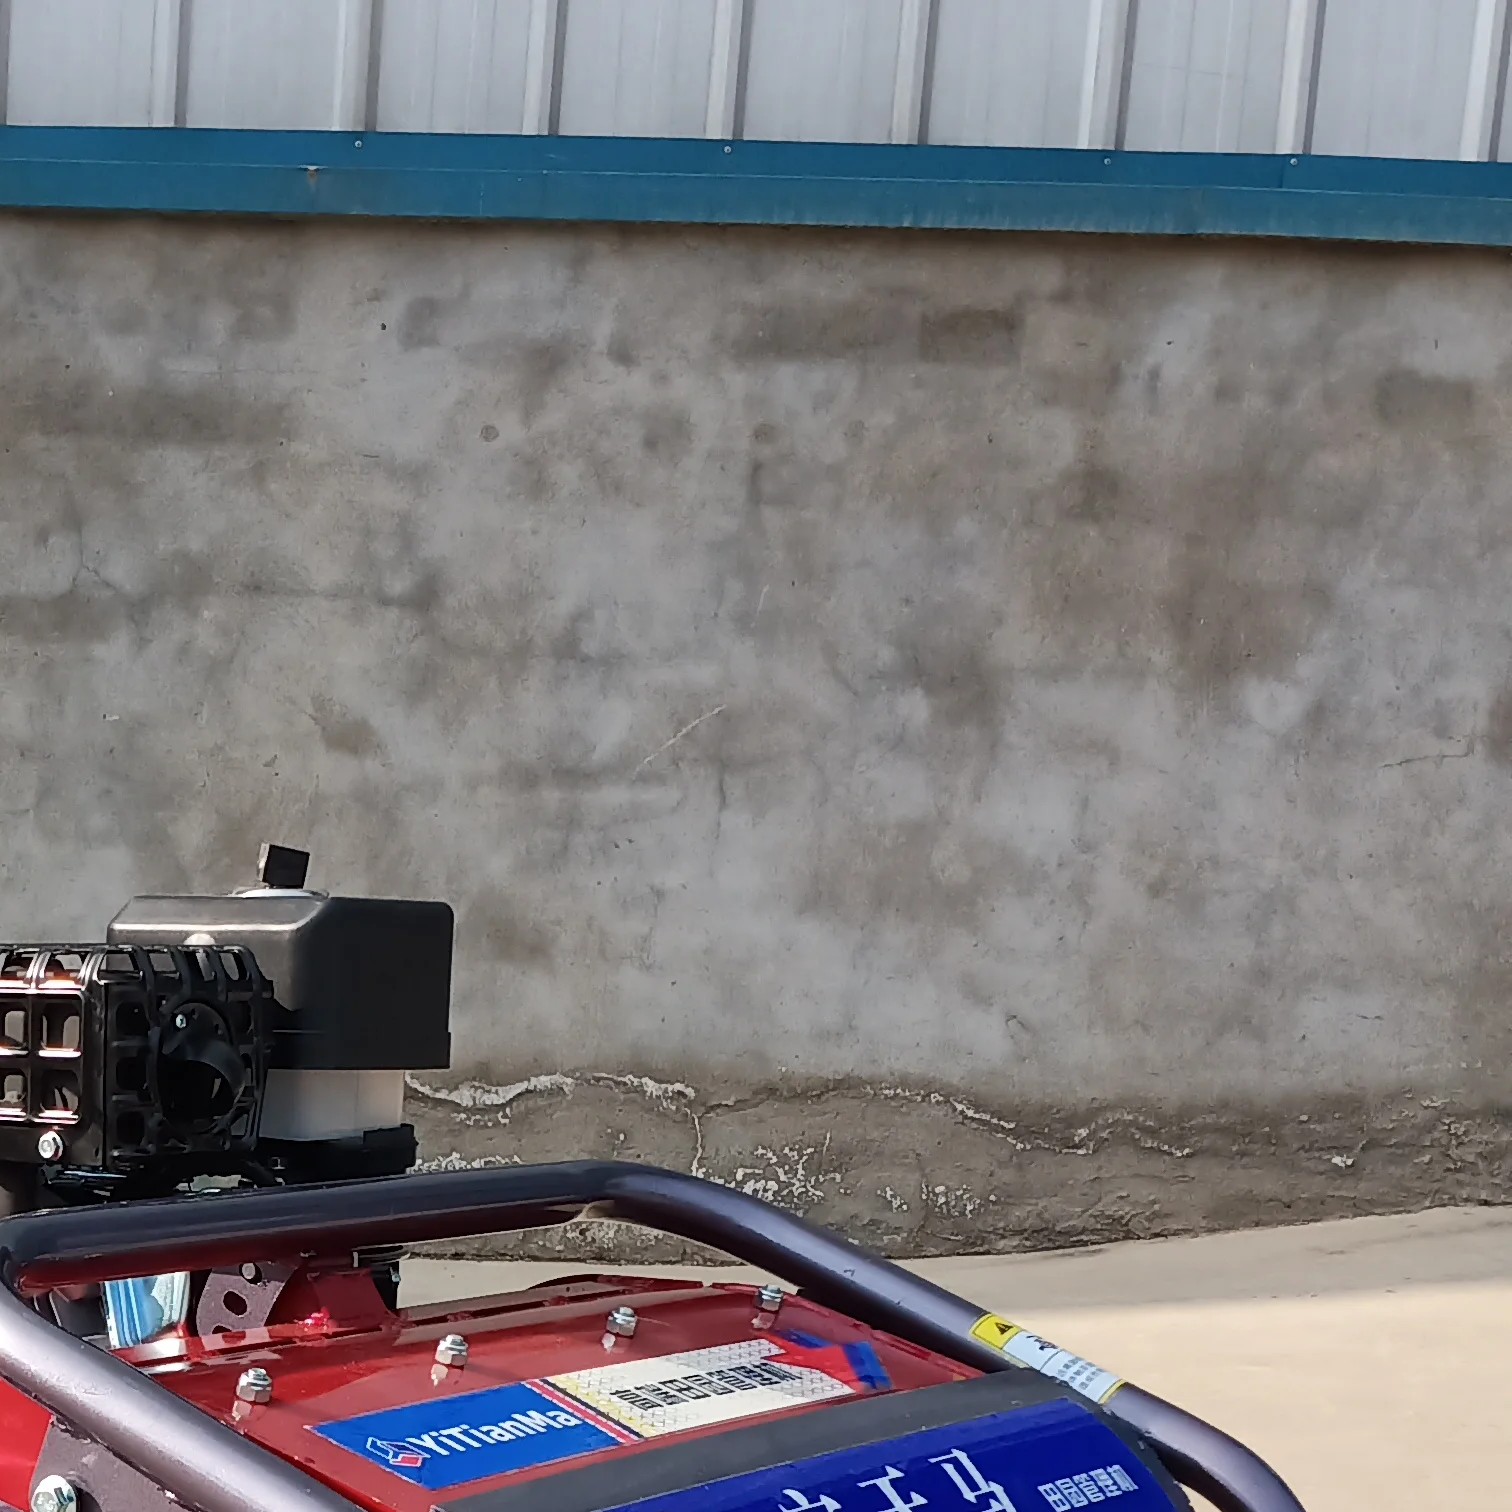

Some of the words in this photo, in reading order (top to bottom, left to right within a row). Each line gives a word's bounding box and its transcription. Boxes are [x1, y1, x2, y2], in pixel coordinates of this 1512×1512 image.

[404, 1409, 582, 1456] YiTianMa
[1037, 1464, 1139, 1512] 田园管理机
